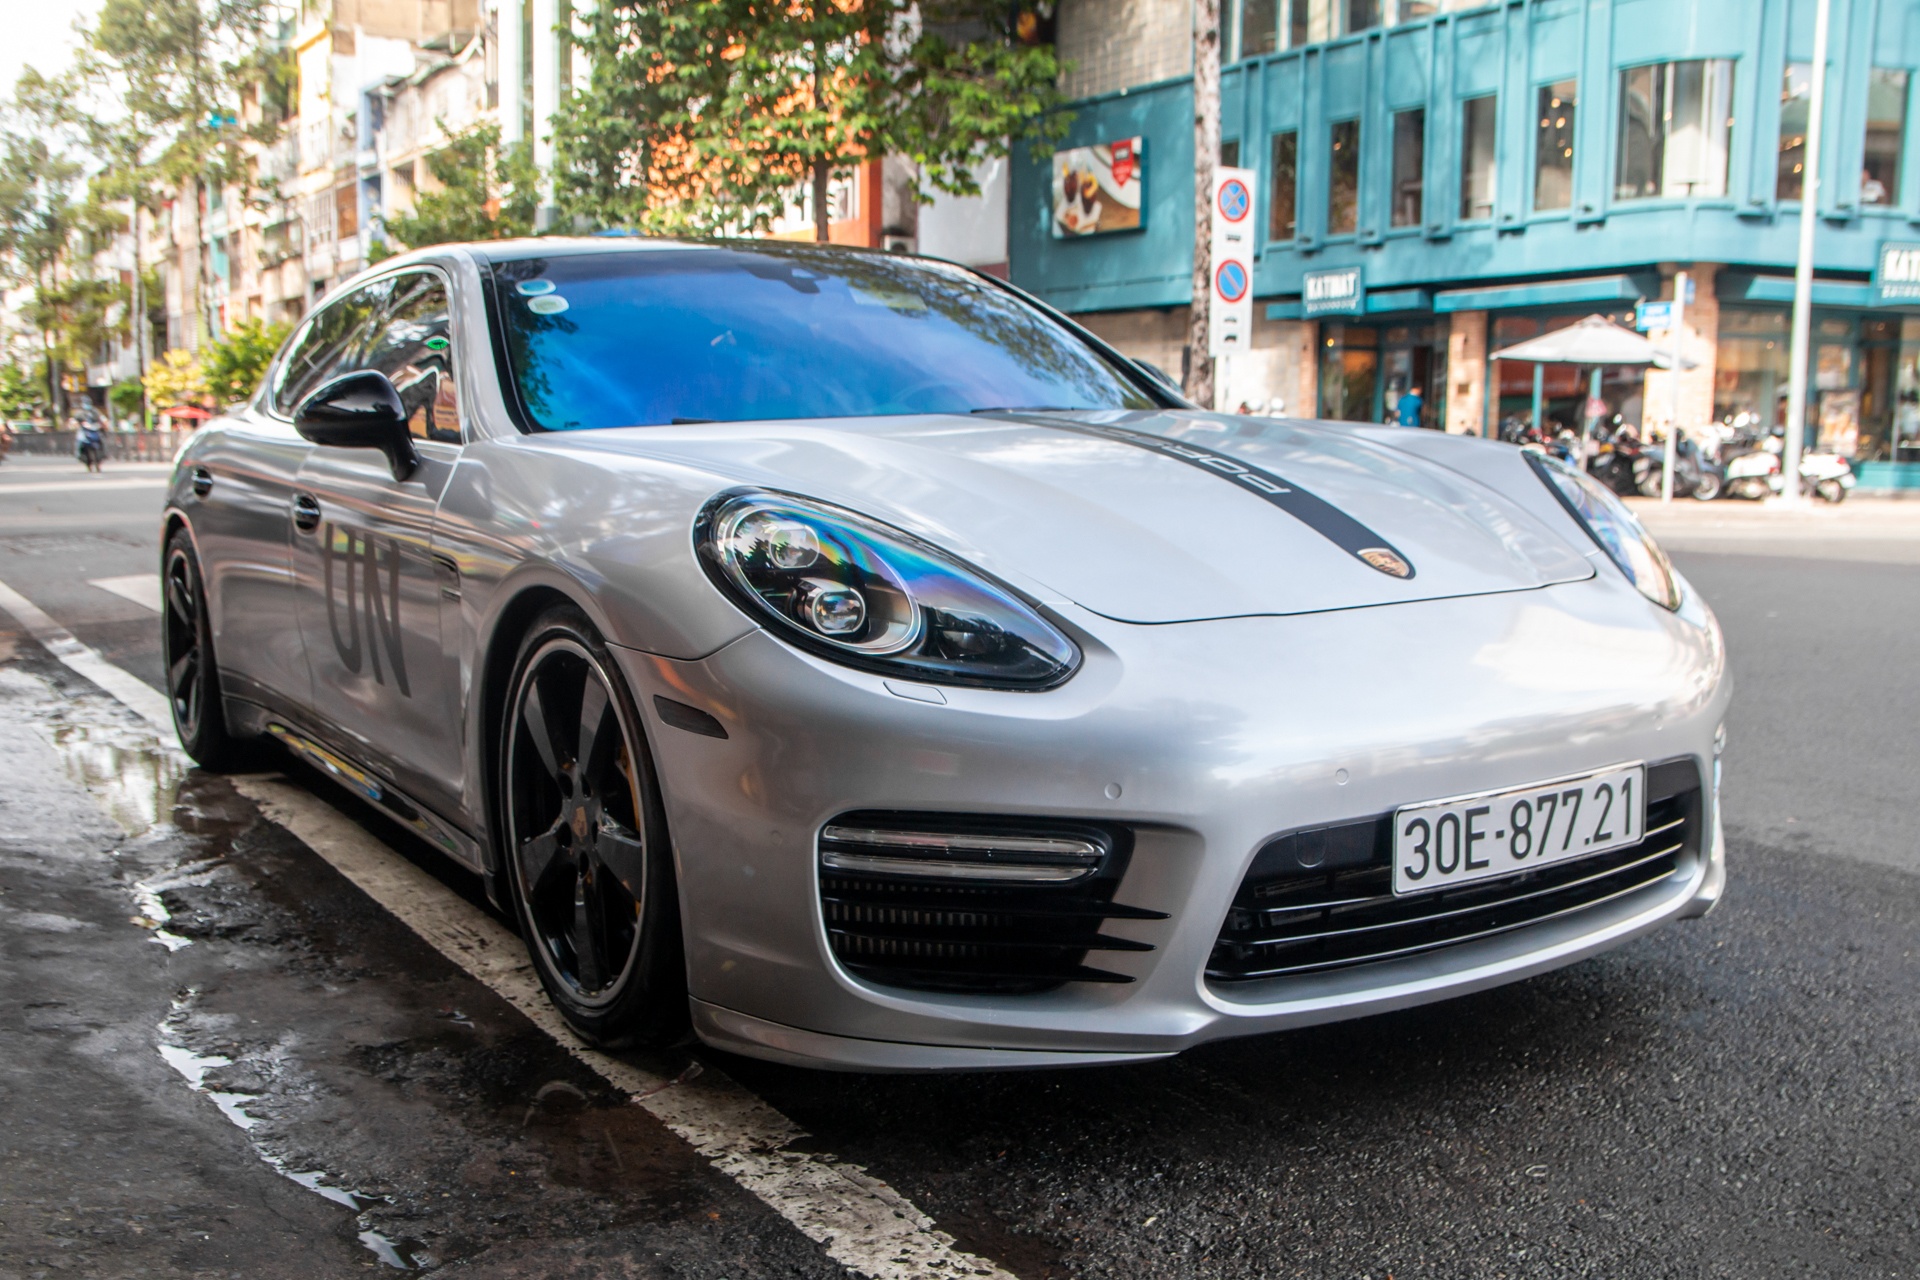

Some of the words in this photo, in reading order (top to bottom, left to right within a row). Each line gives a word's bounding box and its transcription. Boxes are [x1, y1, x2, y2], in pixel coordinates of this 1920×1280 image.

[1029, 417, 1292, 494] PORSC
[324, 522, 412, 699] UN
[1404, 776, 1633, 881] 30E-877.21
